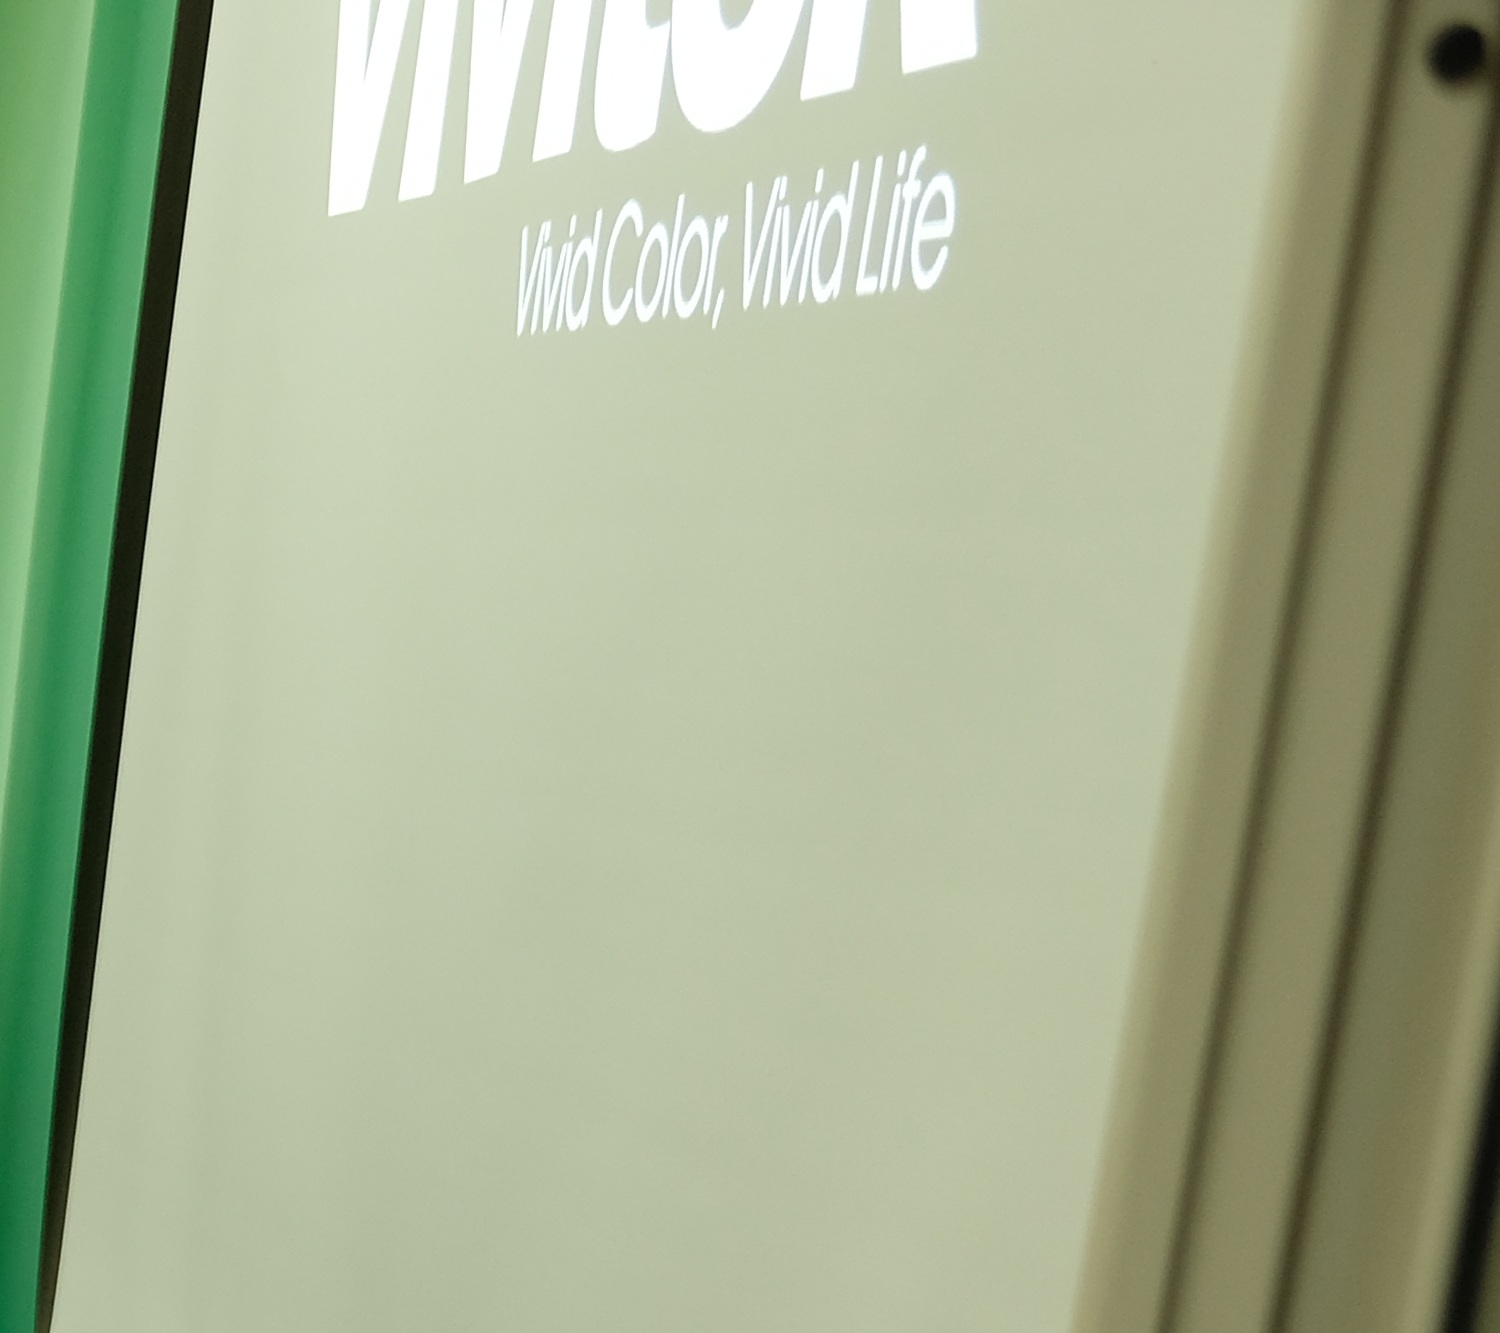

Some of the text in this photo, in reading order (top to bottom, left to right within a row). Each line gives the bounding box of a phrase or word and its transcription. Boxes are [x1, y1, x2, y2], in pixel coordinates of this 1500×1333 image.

[516, 143, 956, 337] Vivid Color, Vivid Life
